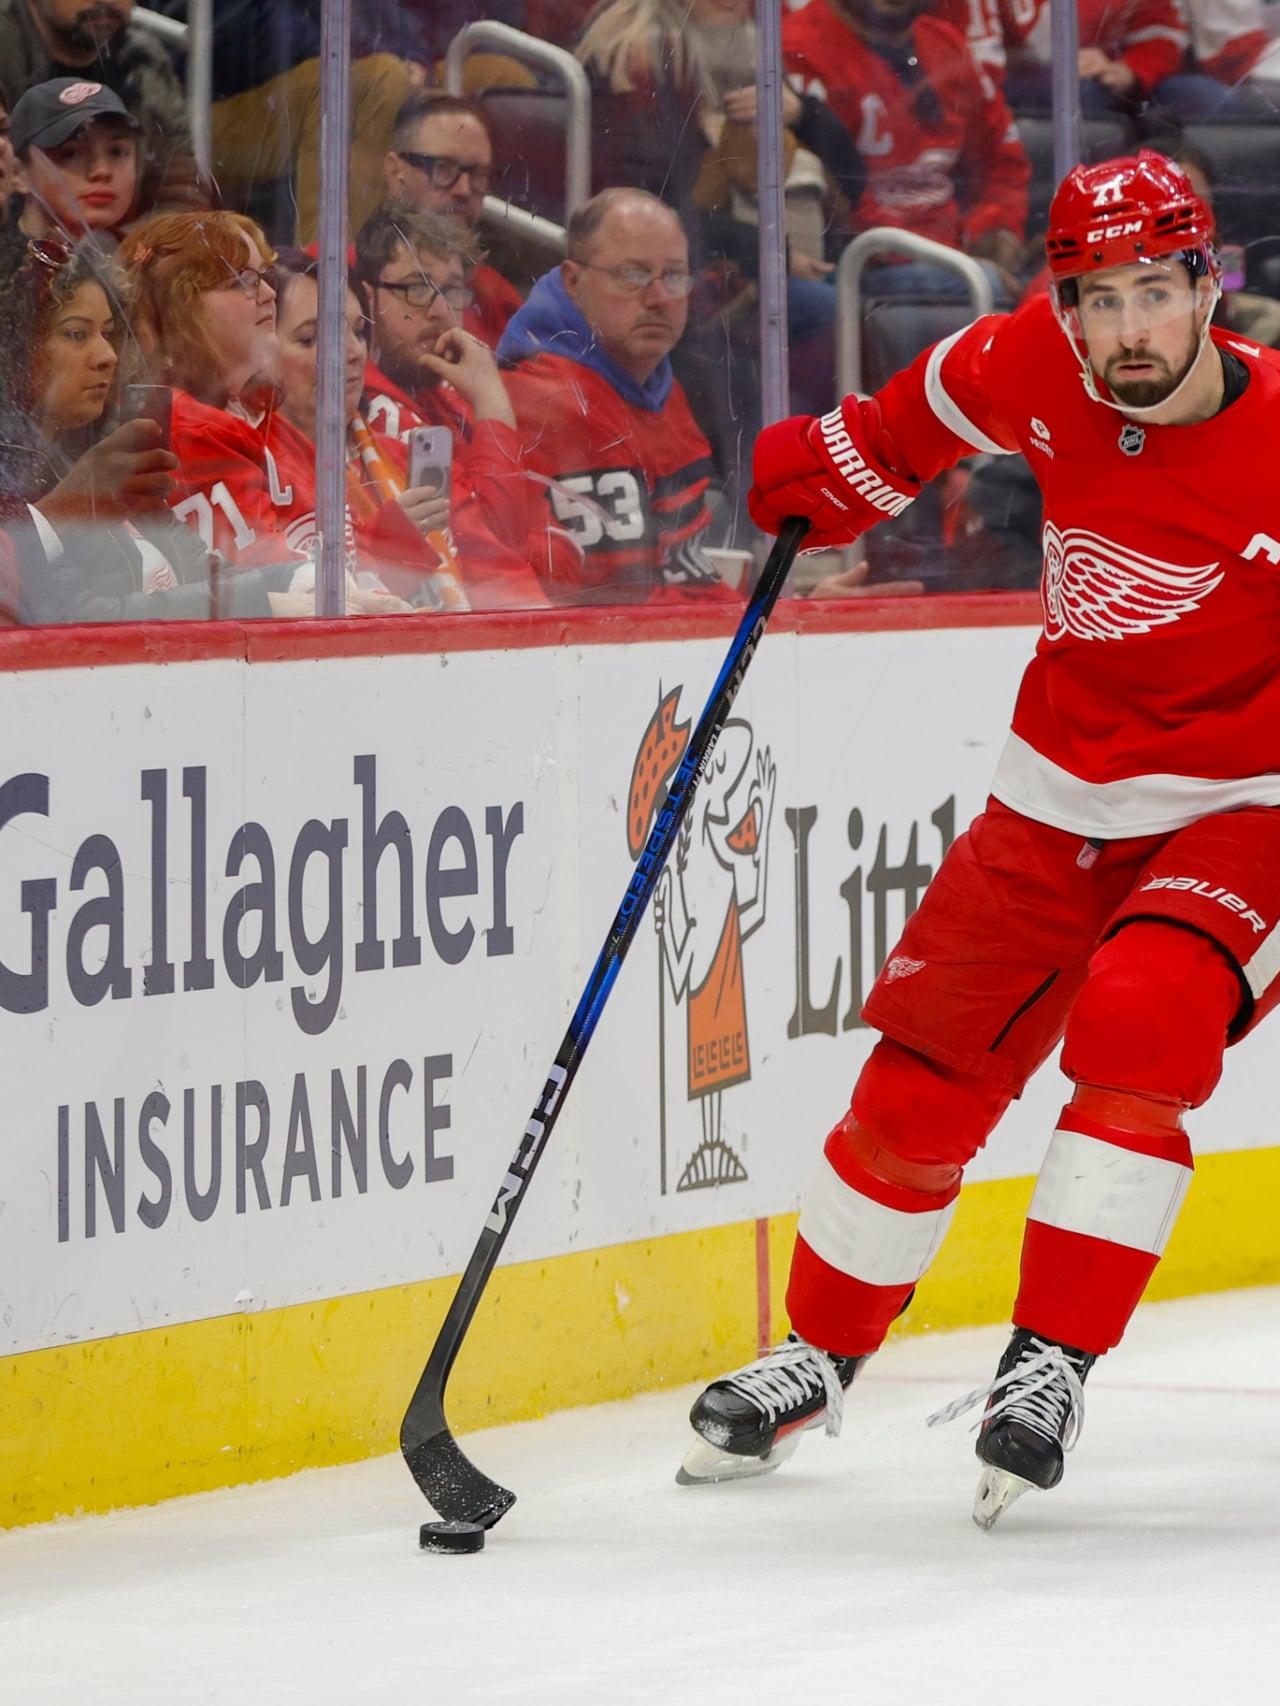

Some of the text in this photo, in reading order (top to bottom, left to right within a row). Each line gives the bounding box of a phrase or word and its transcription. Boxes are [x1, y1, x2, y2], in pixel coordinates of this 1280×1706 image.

[1093, 173, 1124, 207] 71
[1087, 220, 1143, 243] CCM
[172, 482, 256, 558] 71
[551, 471, 645, 547] 53
[820, 487, 849, 511] COVERT
[699, 734, 718, 775] LARKIN
[621, 746, 699, 916] JETSPEED
[0, 754, 524, 1036] Gallagher
[785, 793, 955, 1040] Litt
[1140, 875, 1266, 934] BAUER
[58, 1053, 454, 1243] INSURANCE
[485, 1063, 568, 1236] CCM
